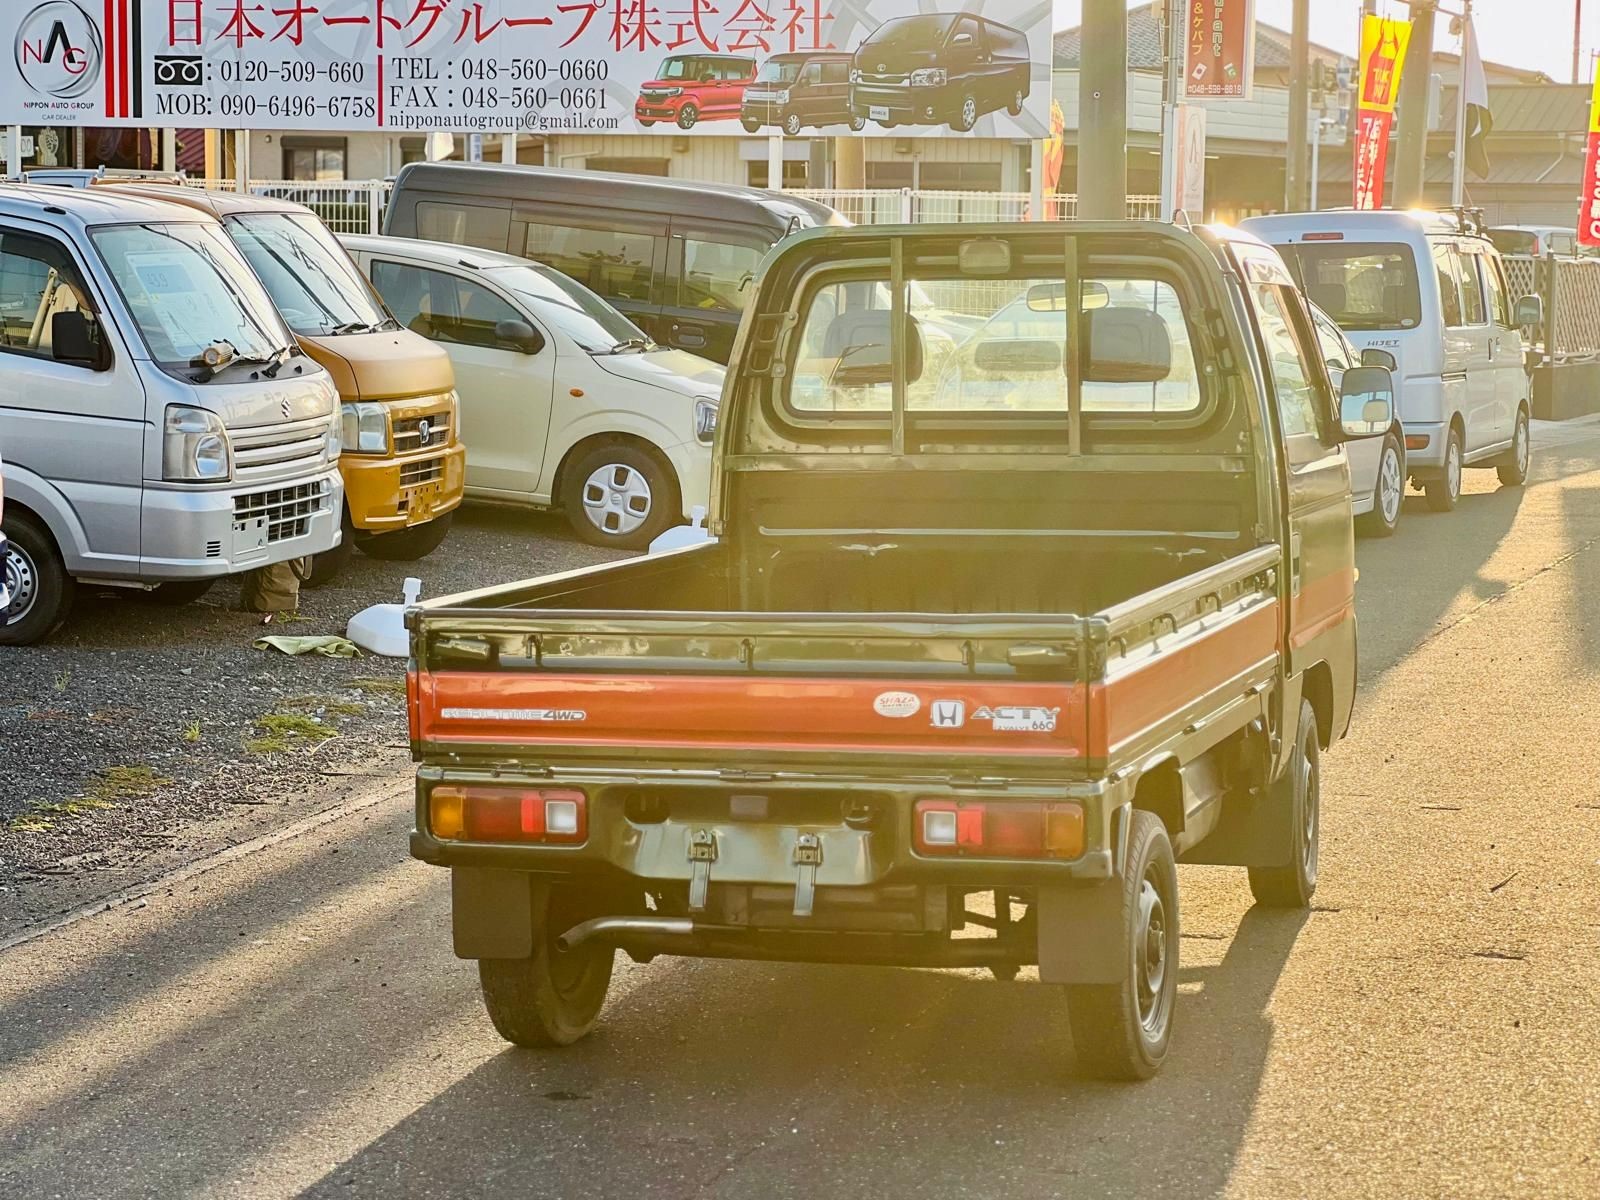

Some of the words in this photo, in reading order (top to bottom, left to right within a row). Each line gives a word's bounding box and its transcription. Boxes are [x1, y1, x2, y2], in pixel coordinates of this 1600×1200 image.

[168, 0, 836, 52] 日本オートグループ株式会社
[221, 60, 364, 83] 0120-509-660
[461, 58, 609, 81] 048-560-0660
[221, 94, 376, 118] 090-6496-6758
[462, 86, 607, 110] 048-560-0661
[389, 110, 618, 130] nipponautogroup@gmail.com
[971, 706, 1060, 719] ACTY
[1031, 720, 1055, 730] 660
